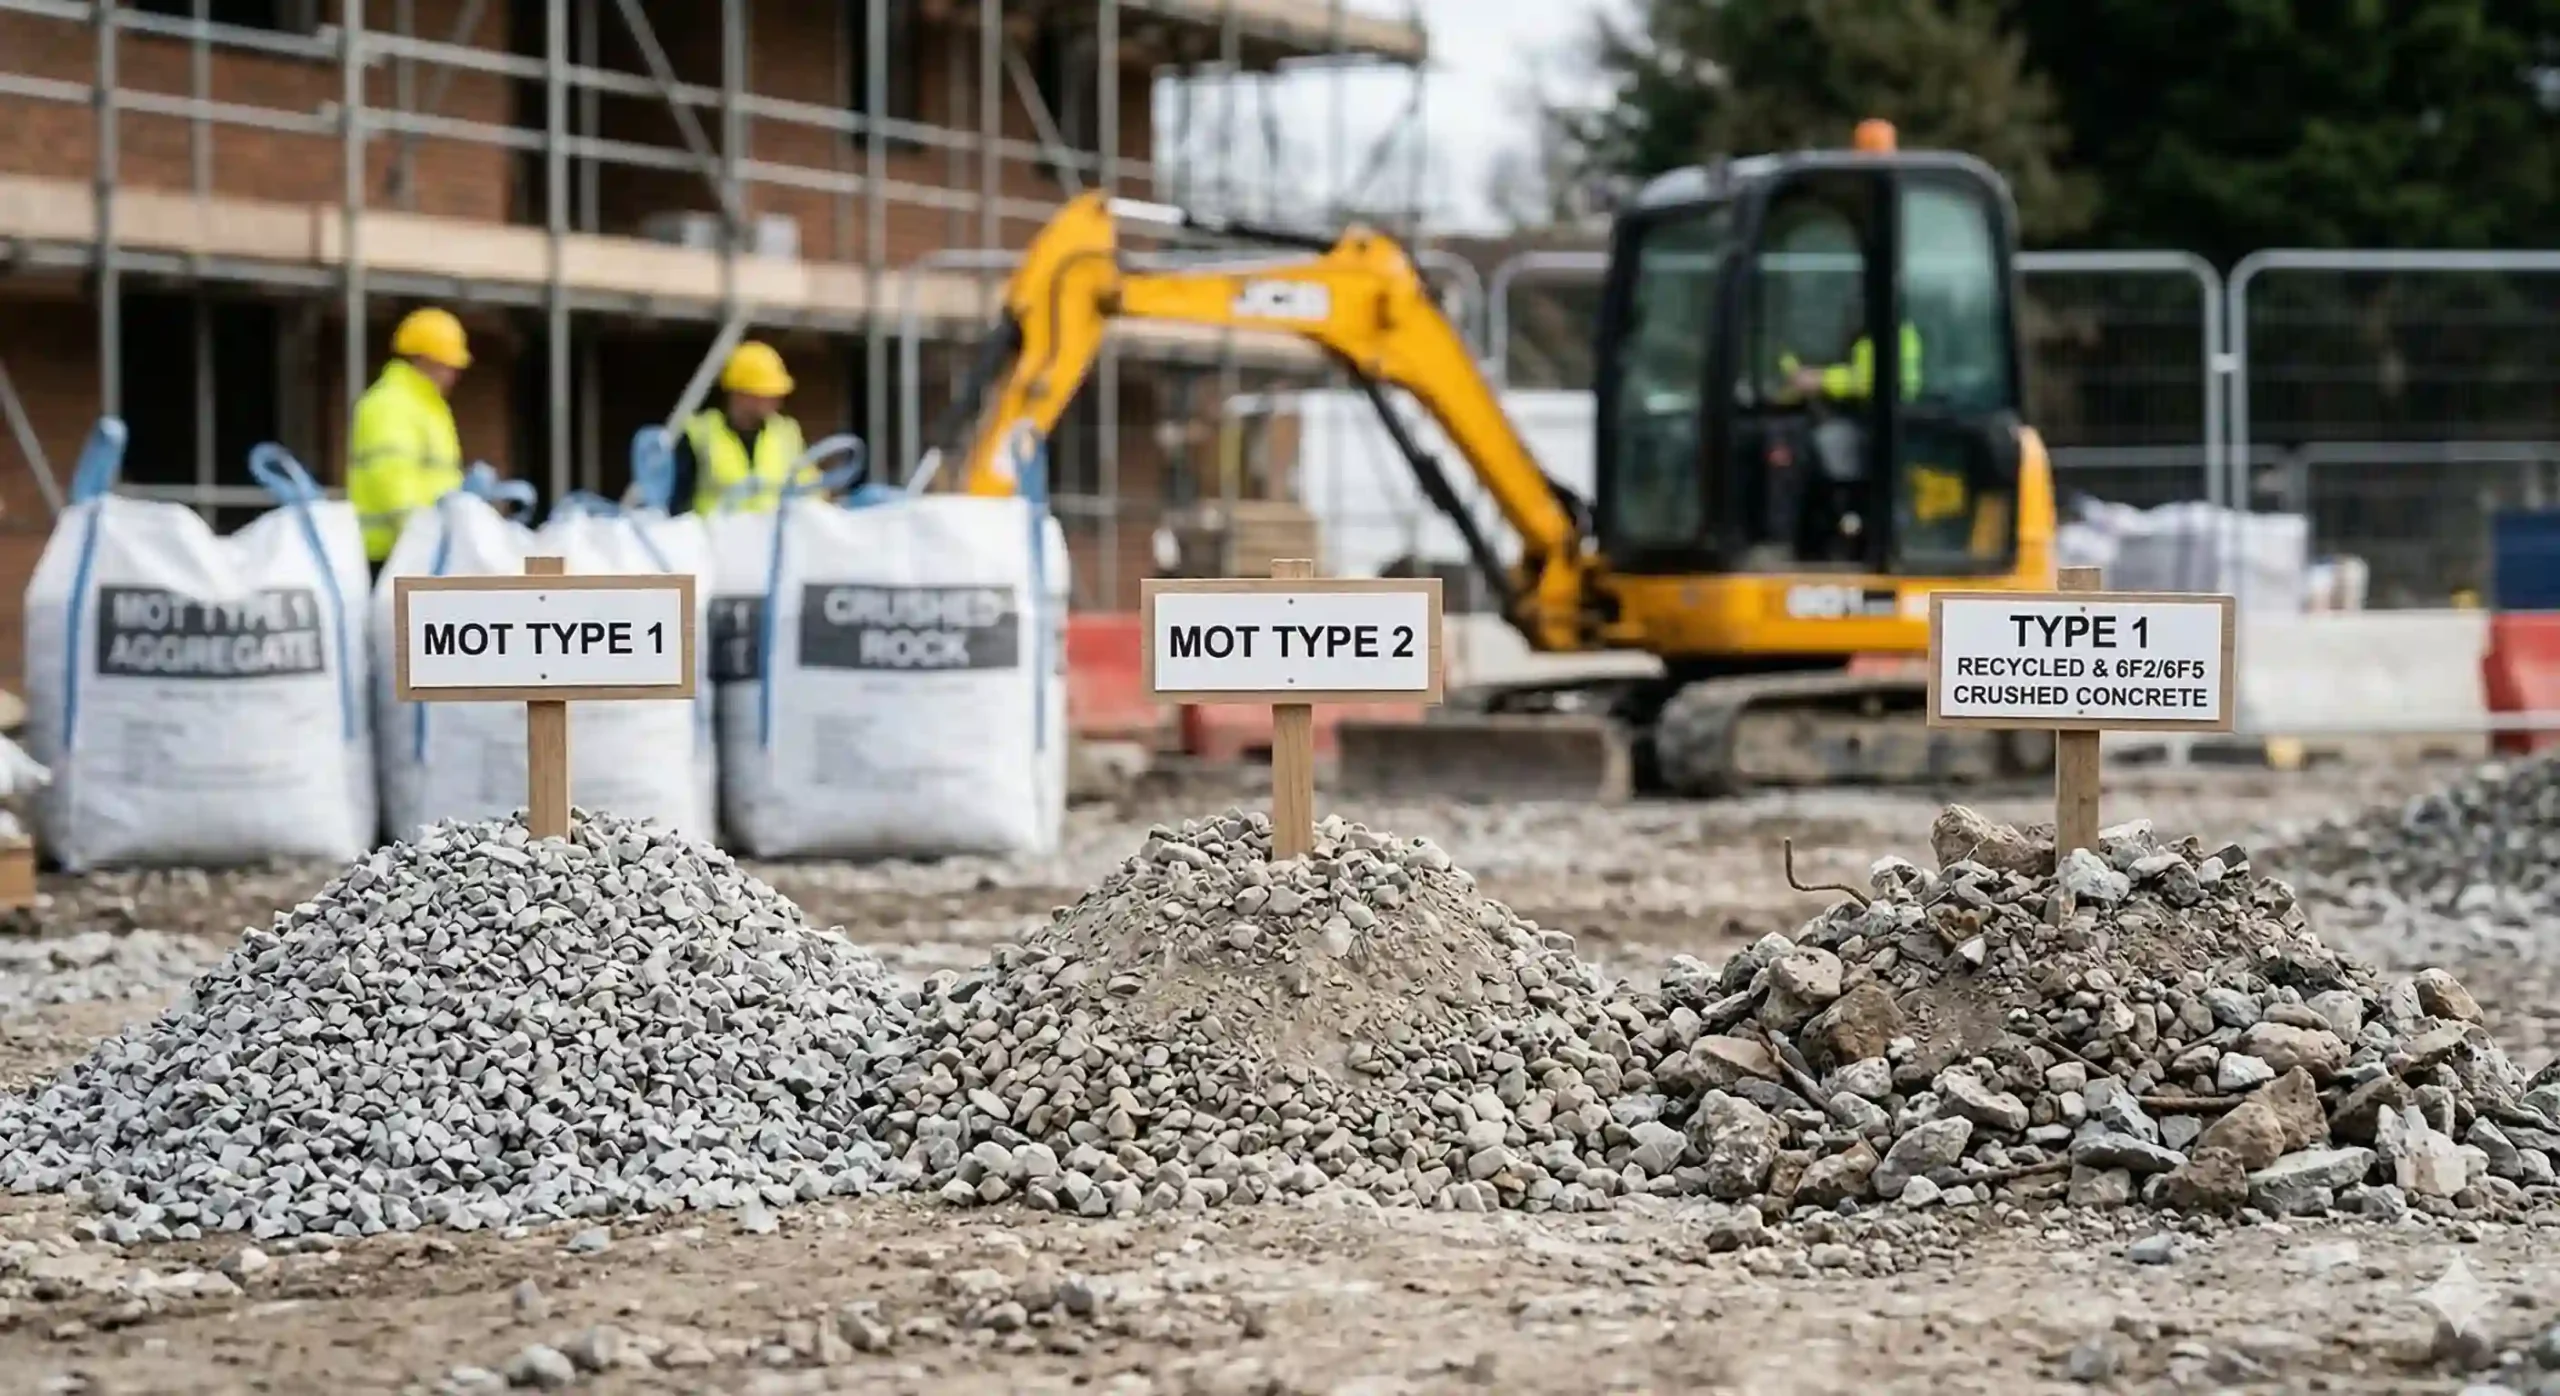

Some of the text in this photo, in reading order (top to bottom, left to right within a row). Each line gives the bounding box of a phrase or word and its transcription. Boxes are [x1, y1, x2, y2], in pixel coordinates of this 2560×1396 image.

[113, 592, 187, 631] MOT
[190, 592, 287, 632] TYPE
[825, 587, 1000, 628] CRUSHED
[424, 621, 663, 656] MOT TYPE 1
[859, 628, 970, 668] ROCK
[1170, 625, 1414, 659] MOT TYPE 2
[2009, 614, 2147, 649] TYPE 1
[107, 631, 321, 674] AGGREGATE
[1958, 657, 2205, 680] RECYCLED & 6F2/6F5
[1953, 685, 2208, 707] CRUSHED CONCRETE
